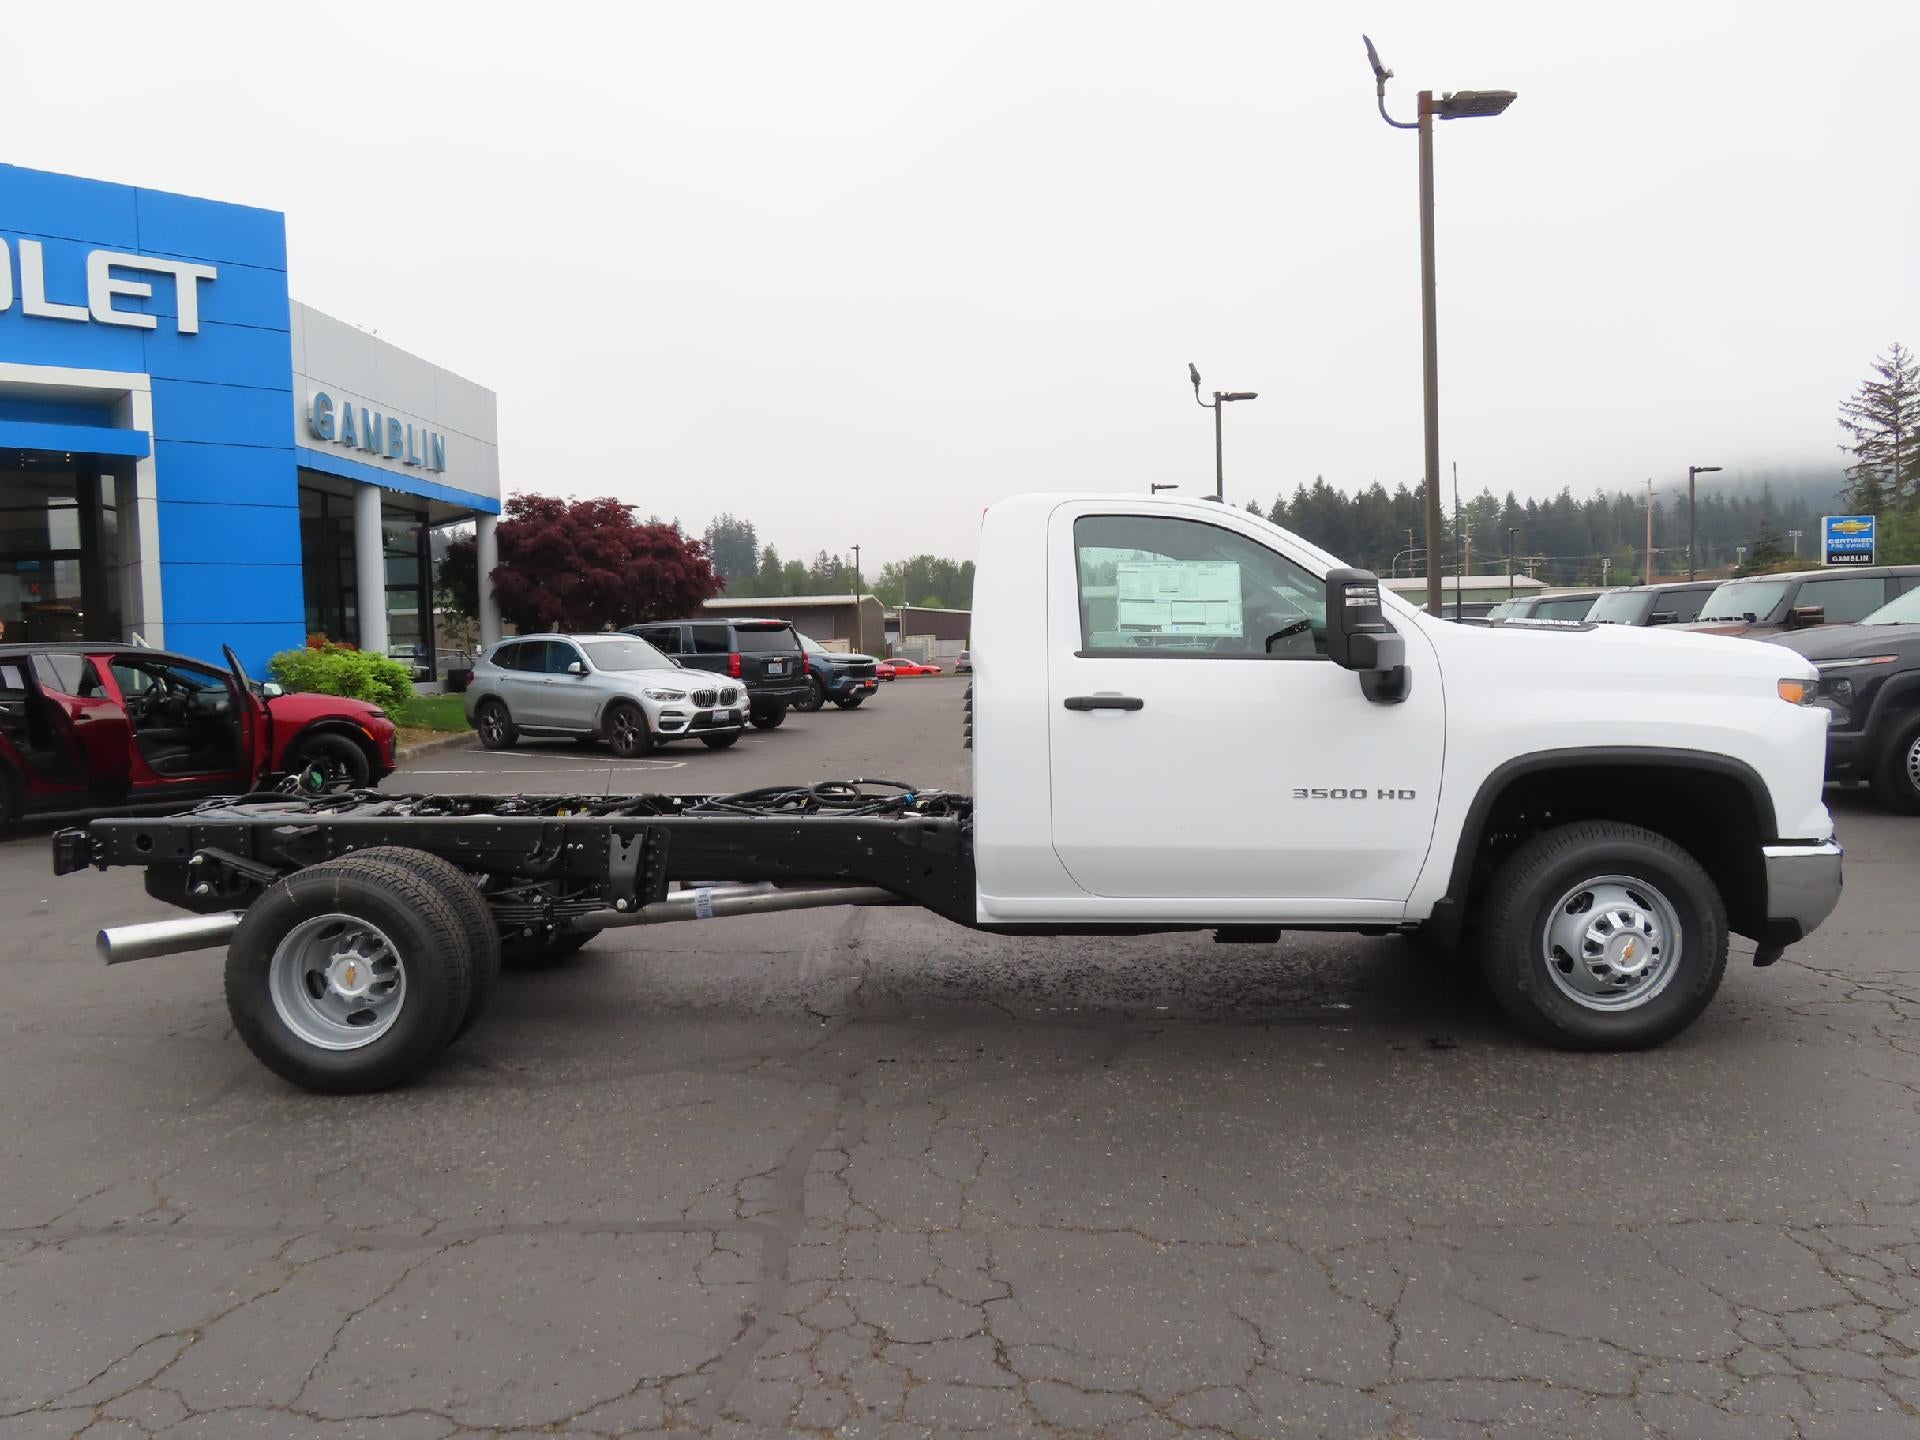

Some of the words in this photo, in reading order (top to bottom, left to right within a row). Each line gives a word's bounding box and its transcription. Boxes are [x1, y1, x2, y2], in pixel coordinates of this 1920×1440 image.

[0, 237, 217, 334] LET
[308, 391, 445, 473] GAMBLIN
[1831, 554, 1869, 562] GAMBLIN
[1292, 788, 1368, 799] 3500
[1377, 789, 1416, 800] HD
